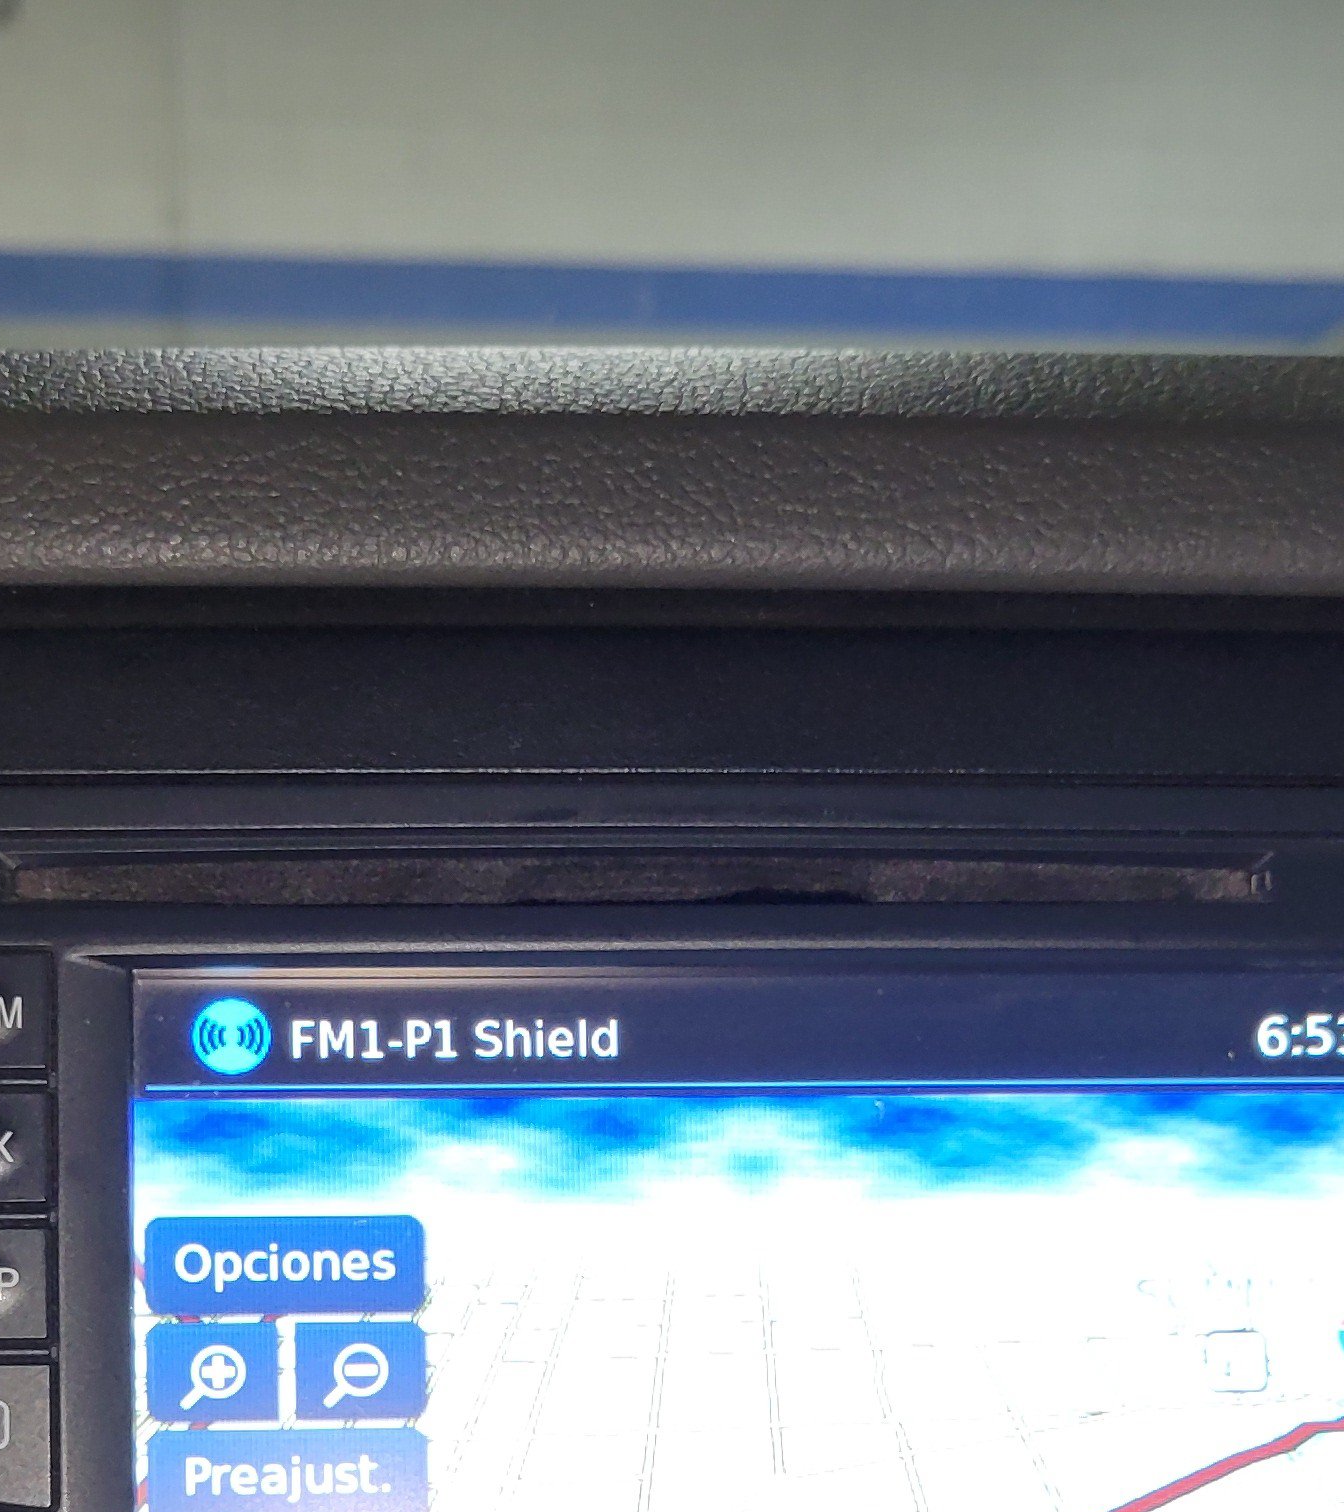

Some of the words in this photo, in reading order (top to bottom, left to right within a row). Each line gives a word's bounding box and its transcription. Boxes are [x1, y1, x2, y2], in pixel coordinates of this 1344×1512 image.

[290, 1019, 459, 1060] FM1-P1
[473, 1018, 620, 1060] Shield
[173, 1242, 397, 1293] Opciones
[184, 1454, 393, 1503] Preajust.
